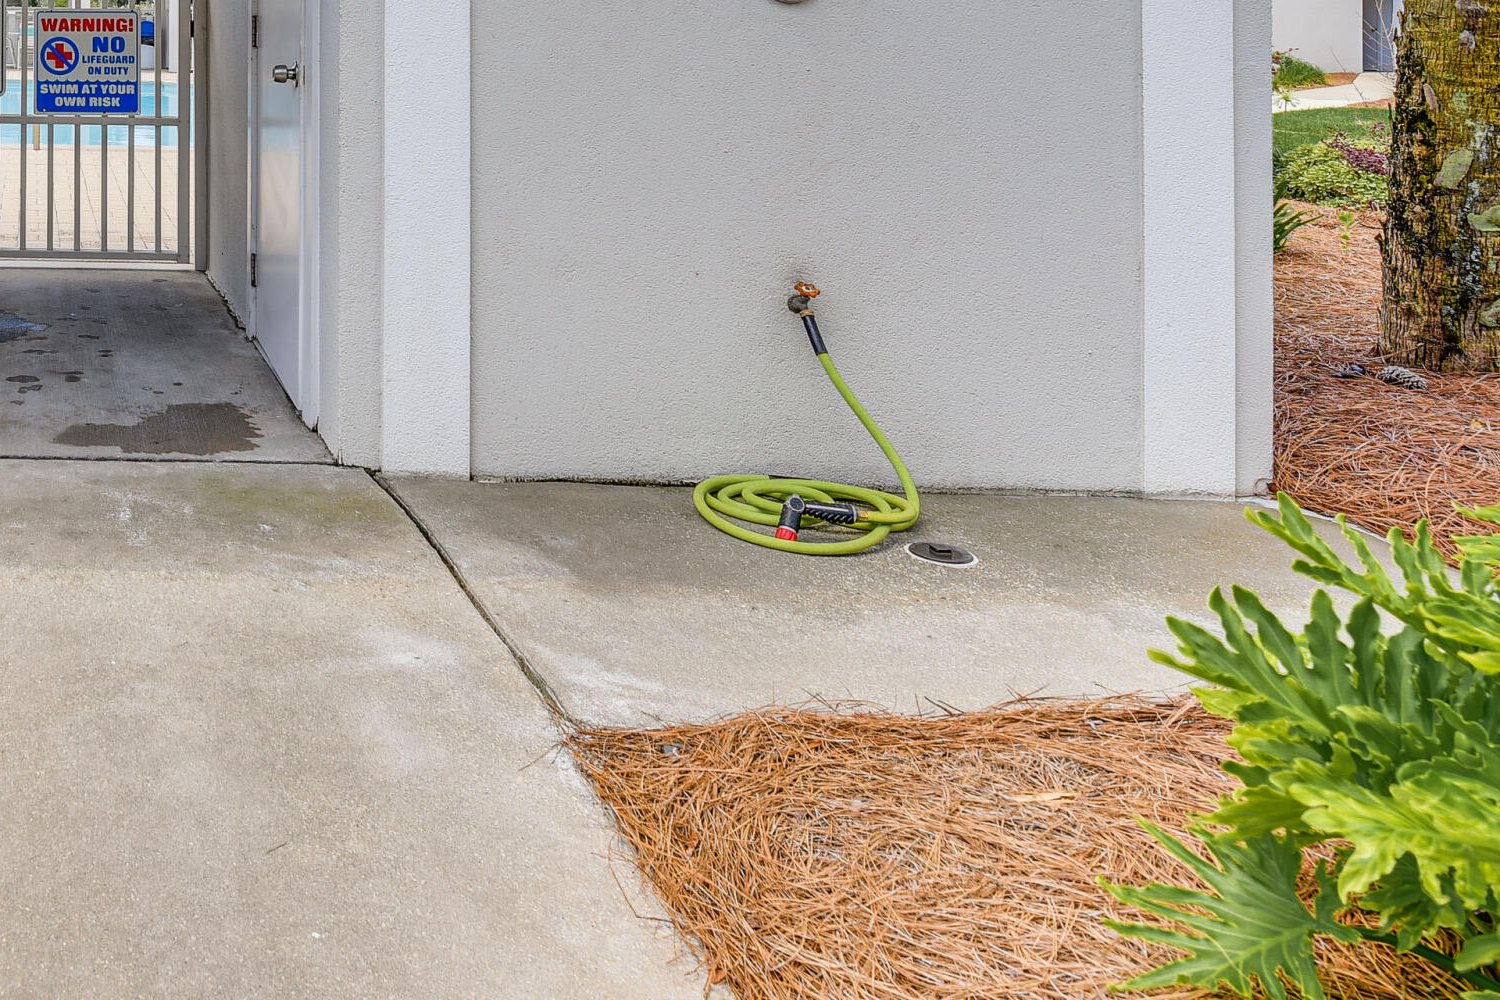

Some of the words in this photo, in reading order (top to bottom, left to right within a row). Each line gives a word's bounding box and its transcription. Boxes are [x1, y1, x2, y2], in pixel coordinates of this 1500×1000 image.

[41, 18, 134, 32] WARNING!
[92, 36, 126, 53] NO
[82, 56, 135, 64] LIFEGUARD
[88, 67, 102, 75] ON
[104, 67, 129, 75] DUTY
[40, 84, 79, 95] SWIM
[81, 84, 97, 95] AT
[100, 84, 135, 95] YOUR
[55, 97, 86, 107] OWN
[89, 97, 121, 107] RISK
